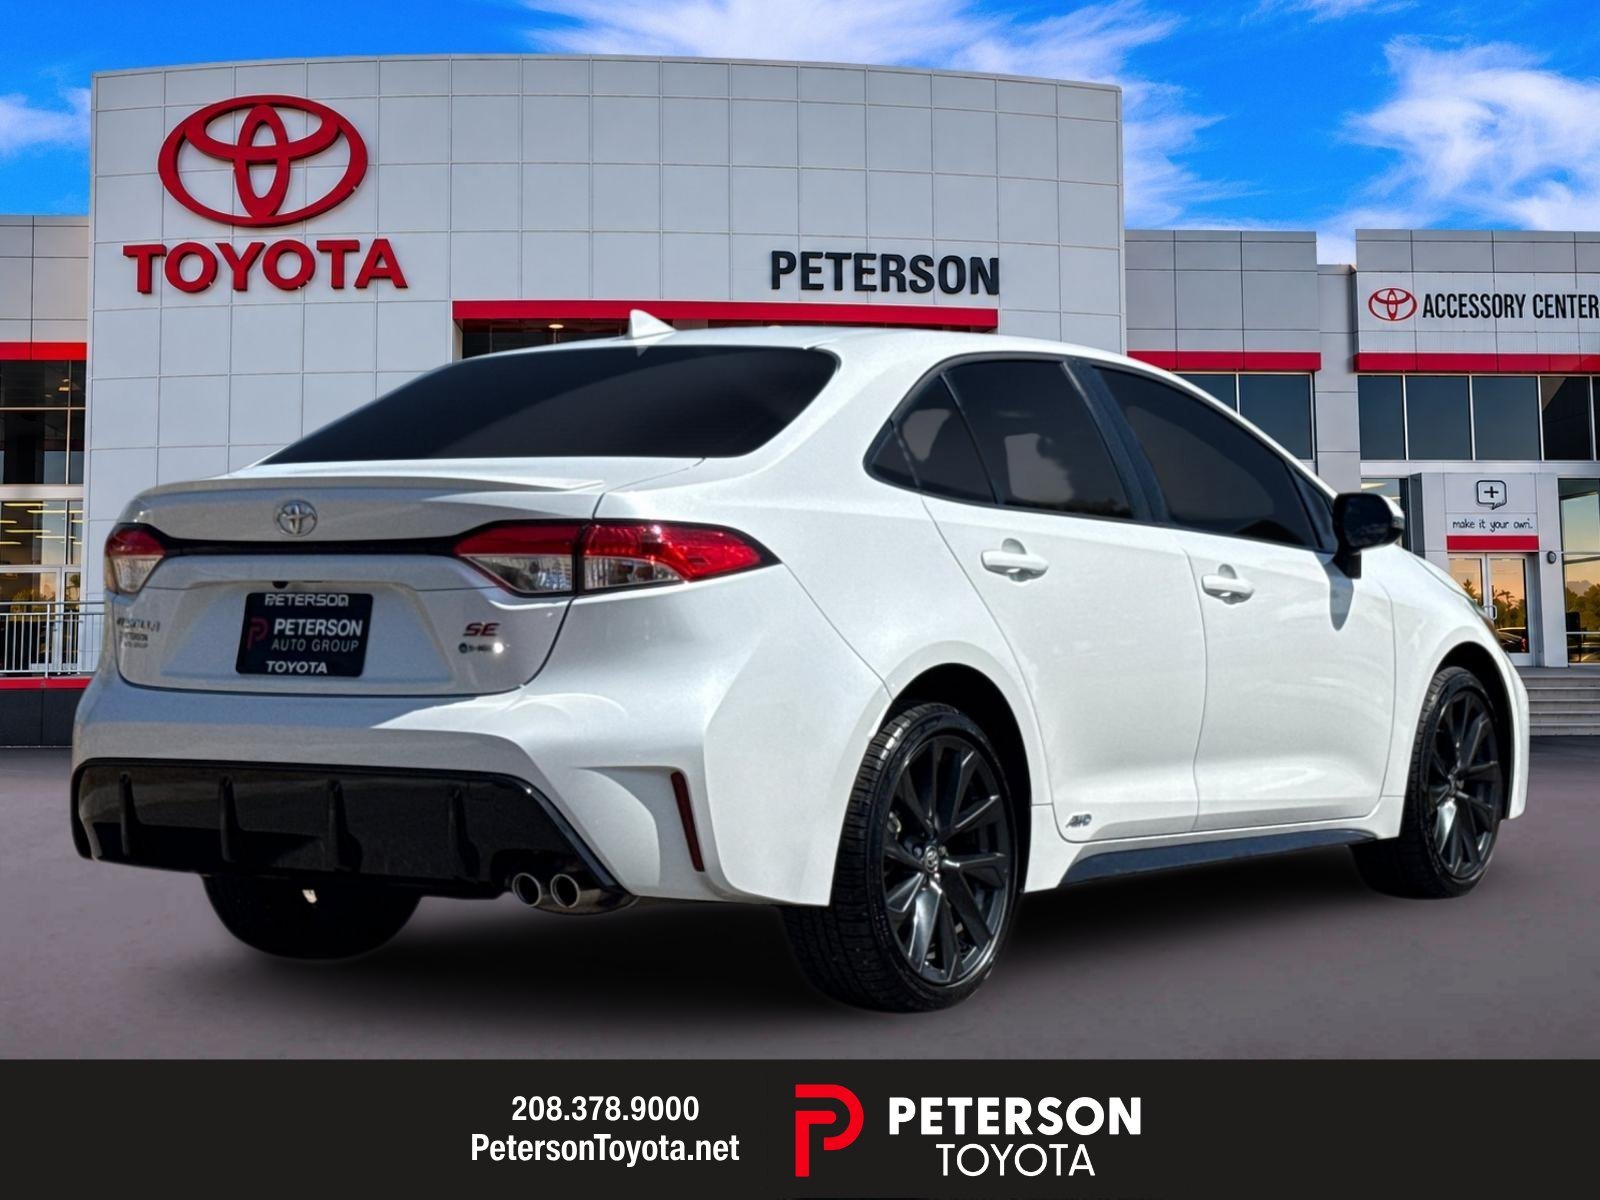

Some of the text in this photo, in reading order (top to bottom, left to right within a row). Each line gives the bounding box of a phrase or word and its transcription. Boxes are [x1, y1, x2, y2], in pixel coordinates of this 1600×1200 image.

[122, 238, 409, 295] TOYOTA
[771, 250, 1000, 295] PETERSON
[1422, 293, 1600, 319] ACCESSORY CENTER
[1452, 519, 1475, 529] make
[1478, 518, 1486, 529] it
[1490, 520, 1509, 533] your
[273, 618, 363, 637] PETERSON
[462, 622, 500, 636] SE
[271, 638, 360, 652] AUTO GROUP
[265, 660, 328, 674] TOYOTA
